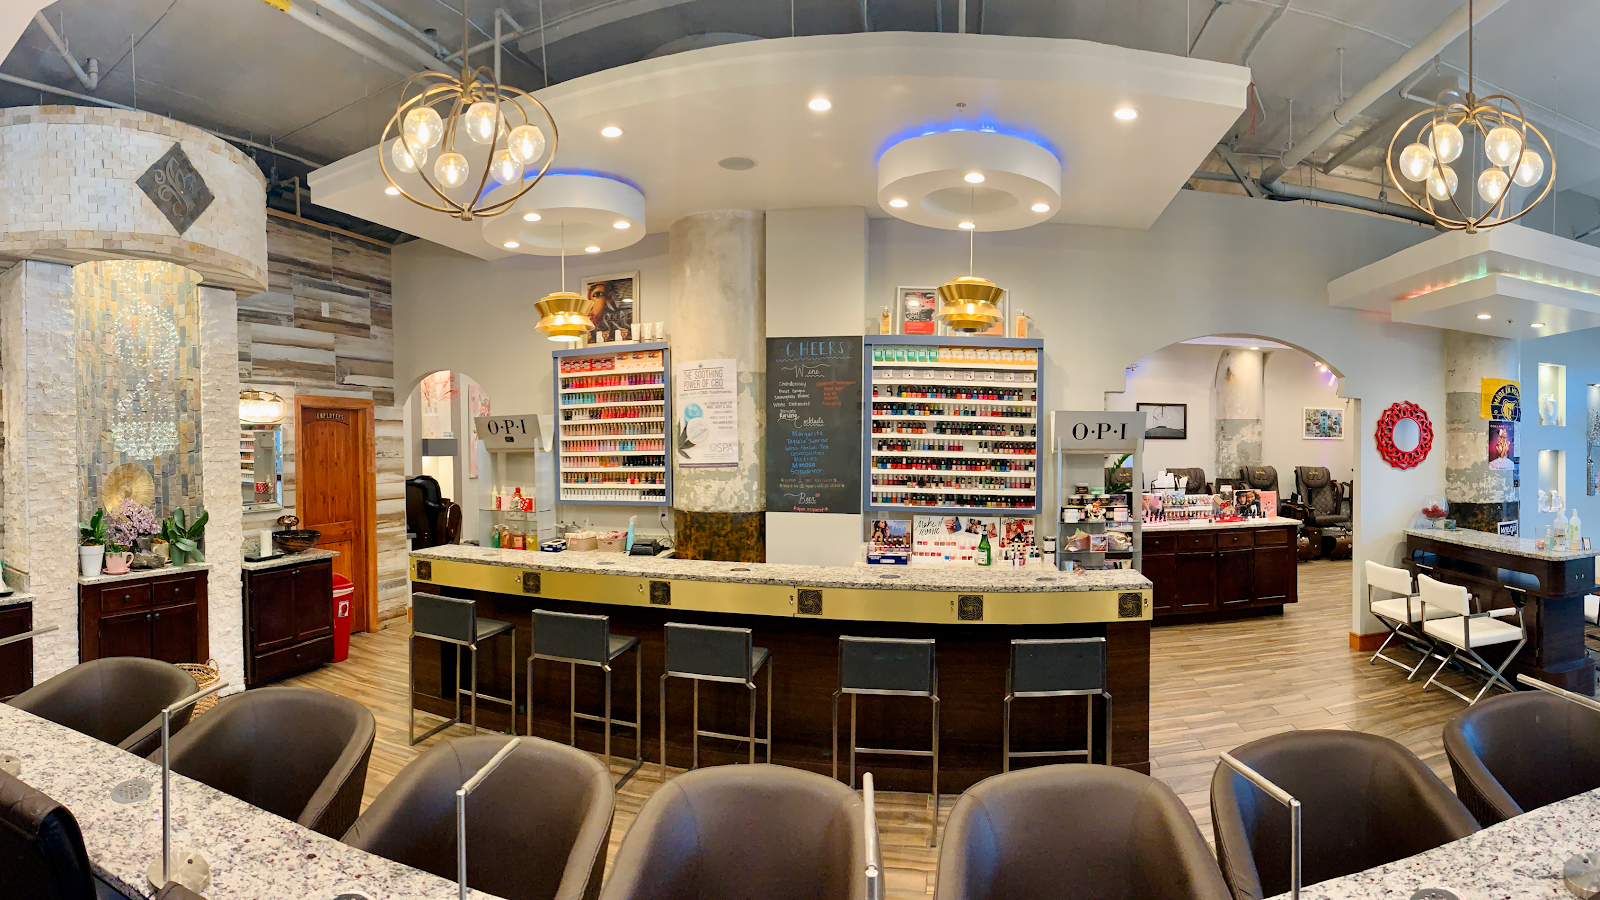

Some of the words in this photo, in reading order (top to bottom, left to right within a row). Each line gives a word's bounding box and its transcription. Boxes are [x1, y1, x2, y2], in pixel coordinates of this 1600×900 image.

[786, 341, 844, 357] CHEERS
[684, 371, 692, 380] THE
[694, 369, 724, 380] SOOTHING
[795, 364, 820, 378] Wine
[684, 380, 700, 389] POWER
[702, 380, 709, 388] OF
[711, 378, 724, 388] CBD
[791, 431, 823, 440] Margarita
